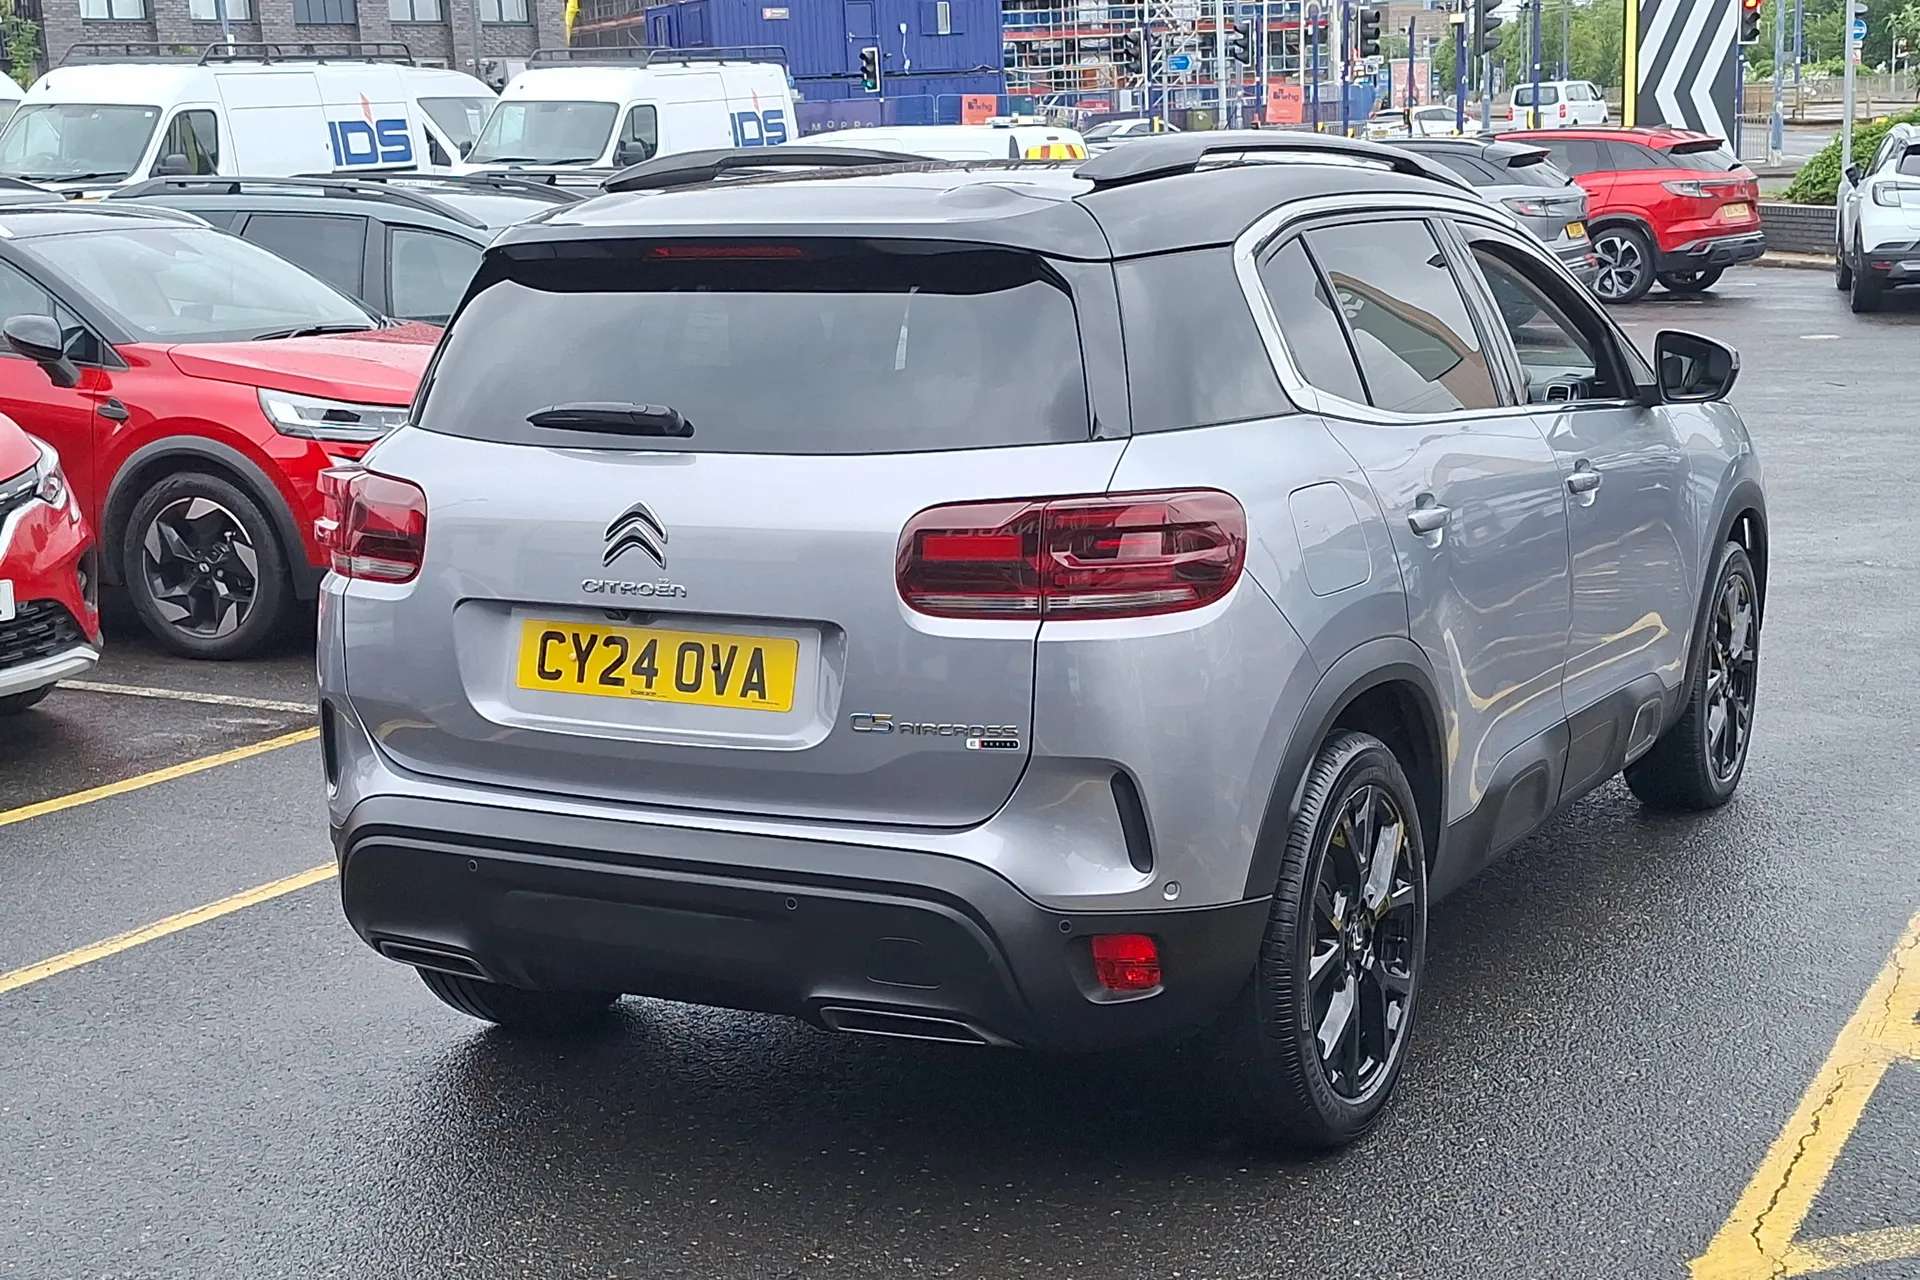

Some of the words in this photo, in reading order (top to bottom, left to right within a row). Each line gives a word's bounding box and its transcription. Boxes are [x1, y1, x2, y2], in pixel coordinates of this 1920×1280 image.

[328, 119, 412, 166] IDS
[729, 109, 787, 148] IDS
[537, 630, 659, 690] CY24
[674, 641, 767, 701] OVA
[849, 712, 895, 733] C5
[898, 721, 1019, 738] AIRCROSS
